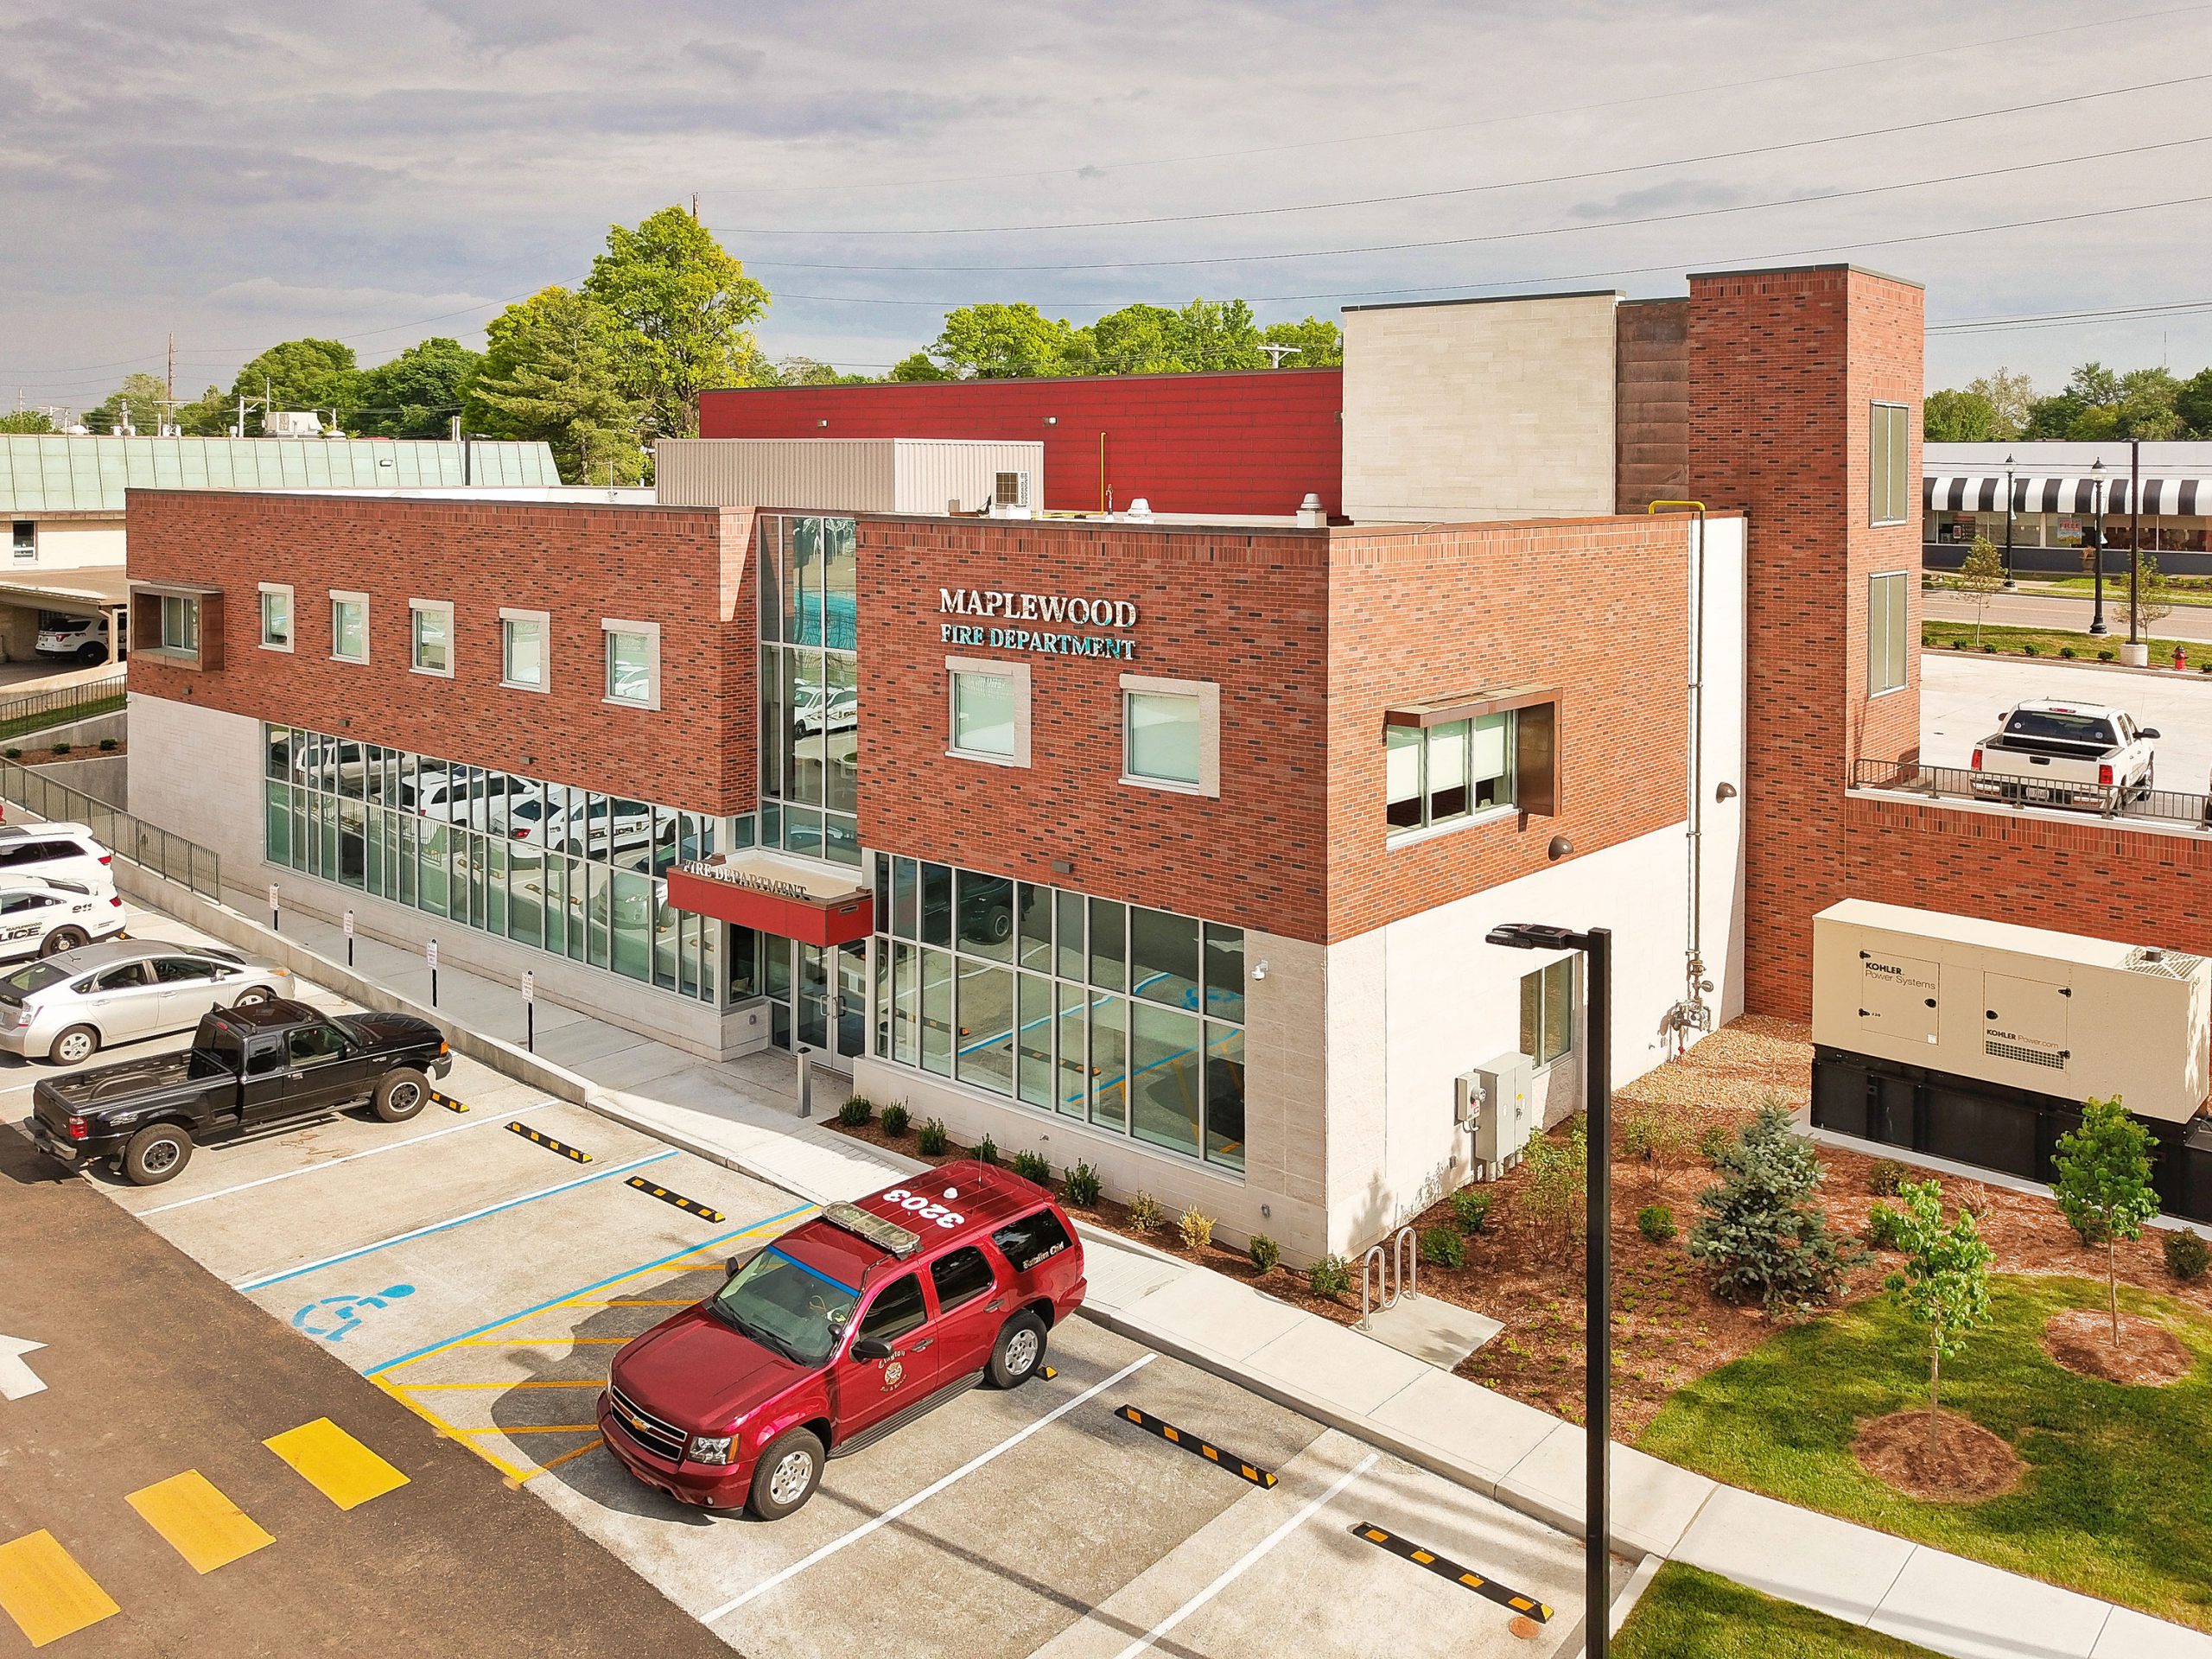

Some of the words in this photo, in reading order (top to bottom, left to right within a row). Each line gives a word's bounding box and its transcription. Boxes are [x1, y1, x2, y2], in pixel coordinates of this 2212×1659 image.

[939, 588, 1137, 627] MAPLEWOOD
[940, 624, 984, 645] FIRE
[989, 628, 1135, 660] DEPARTMENT
[683, 859, 712, 876] FIRE
[715, 867, 808, 899] DEPARTMENT
[72, 903, 92, 913] 911
[1865, 969, 1893, 982] Power
[1896, 976, 1936, 990] Systems
[1866, 962, 1902, 976] KOHLER
[1986, 1029, 2017, 1040] KOHLER
[2018, 1034, 2059, 1049] Power.com
[882, 1189, 965, 1229] 3203
